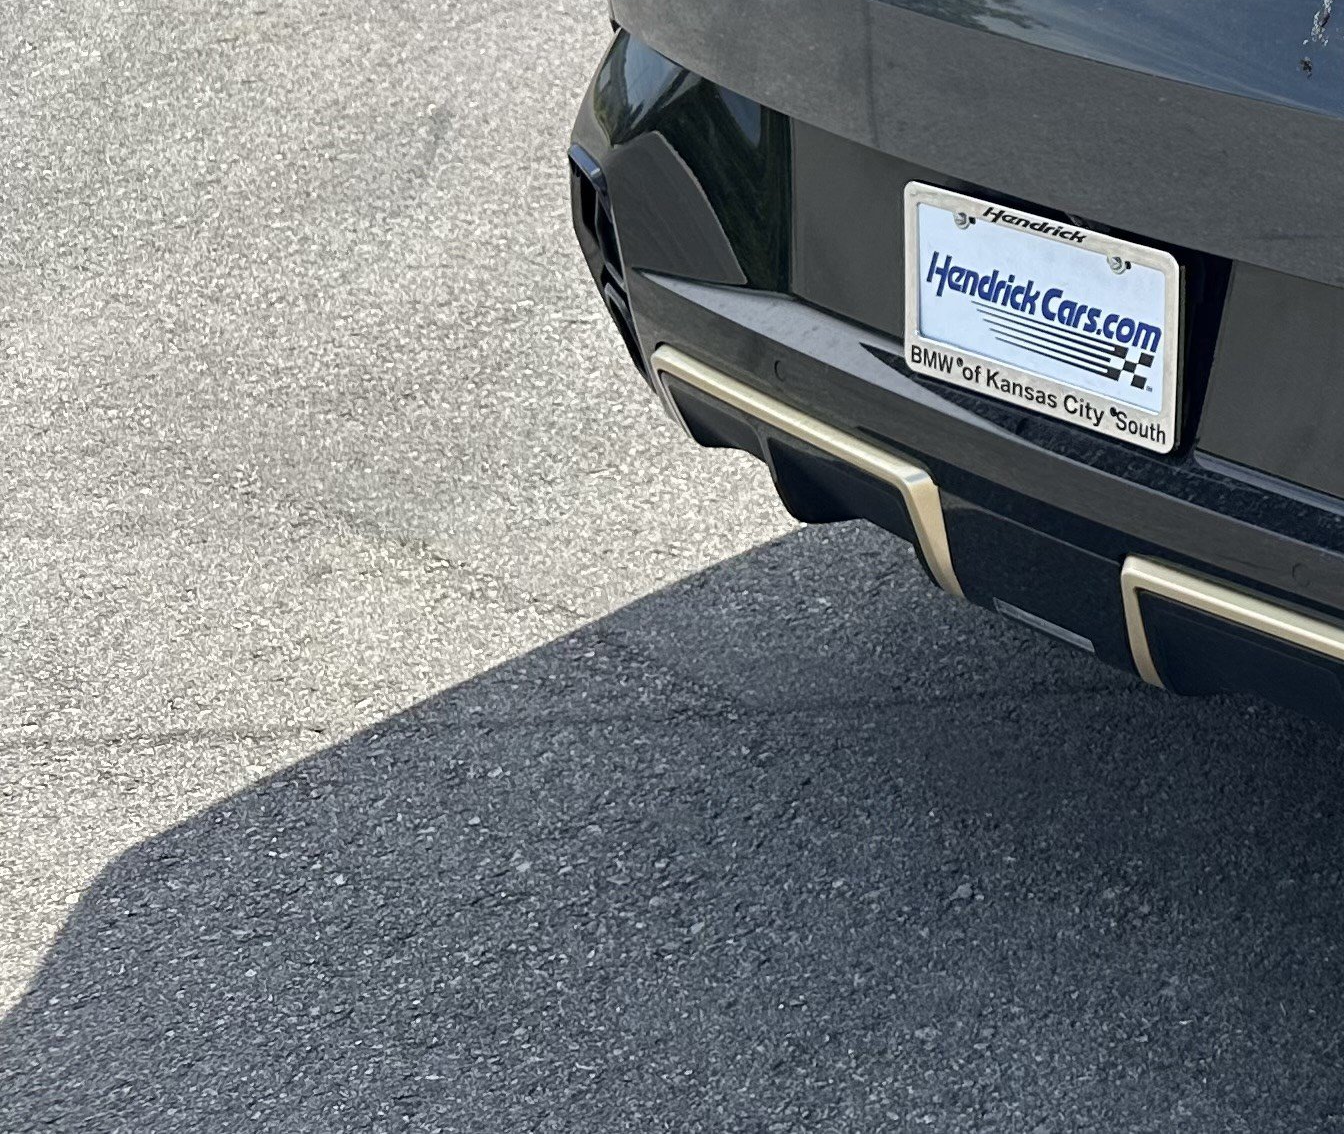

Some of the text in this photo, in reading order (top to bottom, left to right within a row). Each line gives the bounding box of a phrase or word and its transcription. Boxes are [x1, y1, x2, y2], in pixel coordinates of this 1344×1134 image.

[983, 206, 1087, 244] Hendrick
[910, 345, 1167, 445] BMW of Kansas City South
